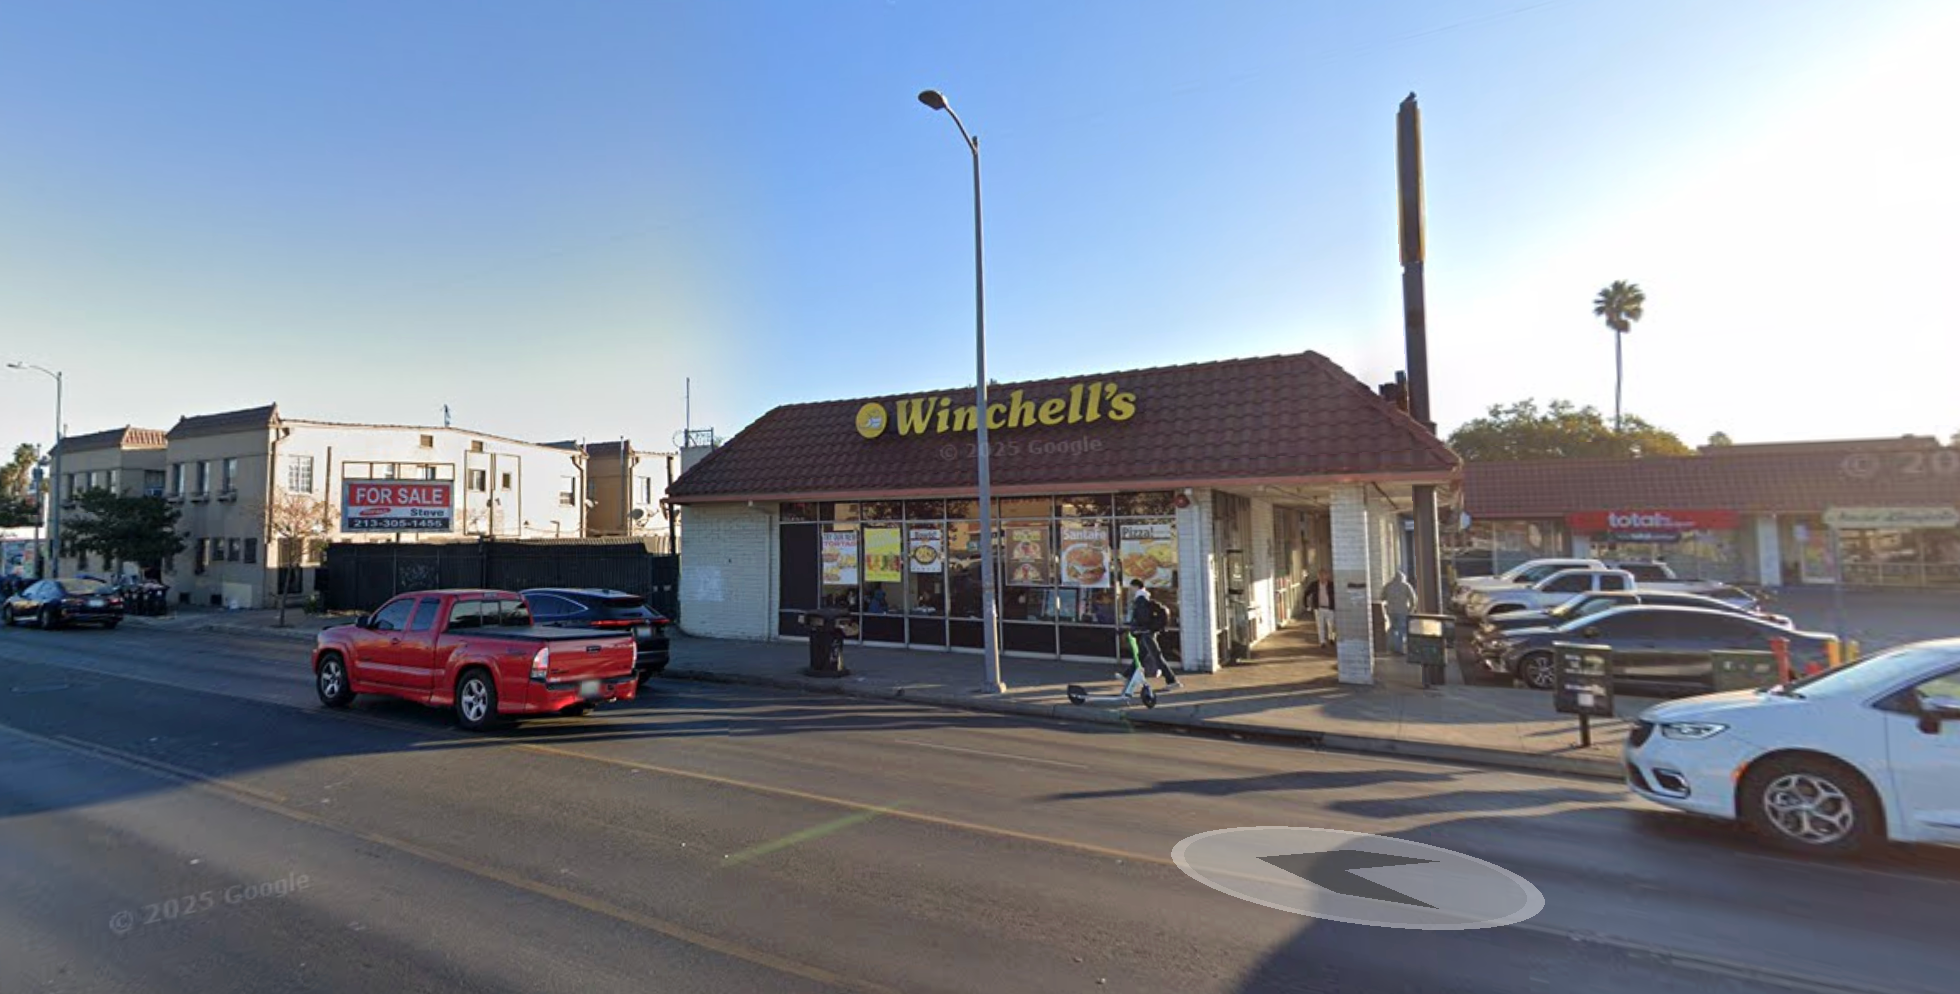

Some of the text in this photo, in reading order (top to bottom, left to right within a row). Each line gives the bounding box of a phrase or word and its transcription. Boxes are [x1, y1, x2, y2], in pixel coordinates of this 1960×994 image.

[896, 381, 1137, 437] Winchell's
[356, 487, 443, 505] FOR SALE
[410, 507, 445, 517] Steve
[1121, 525, 1154, 538] Pizza!
